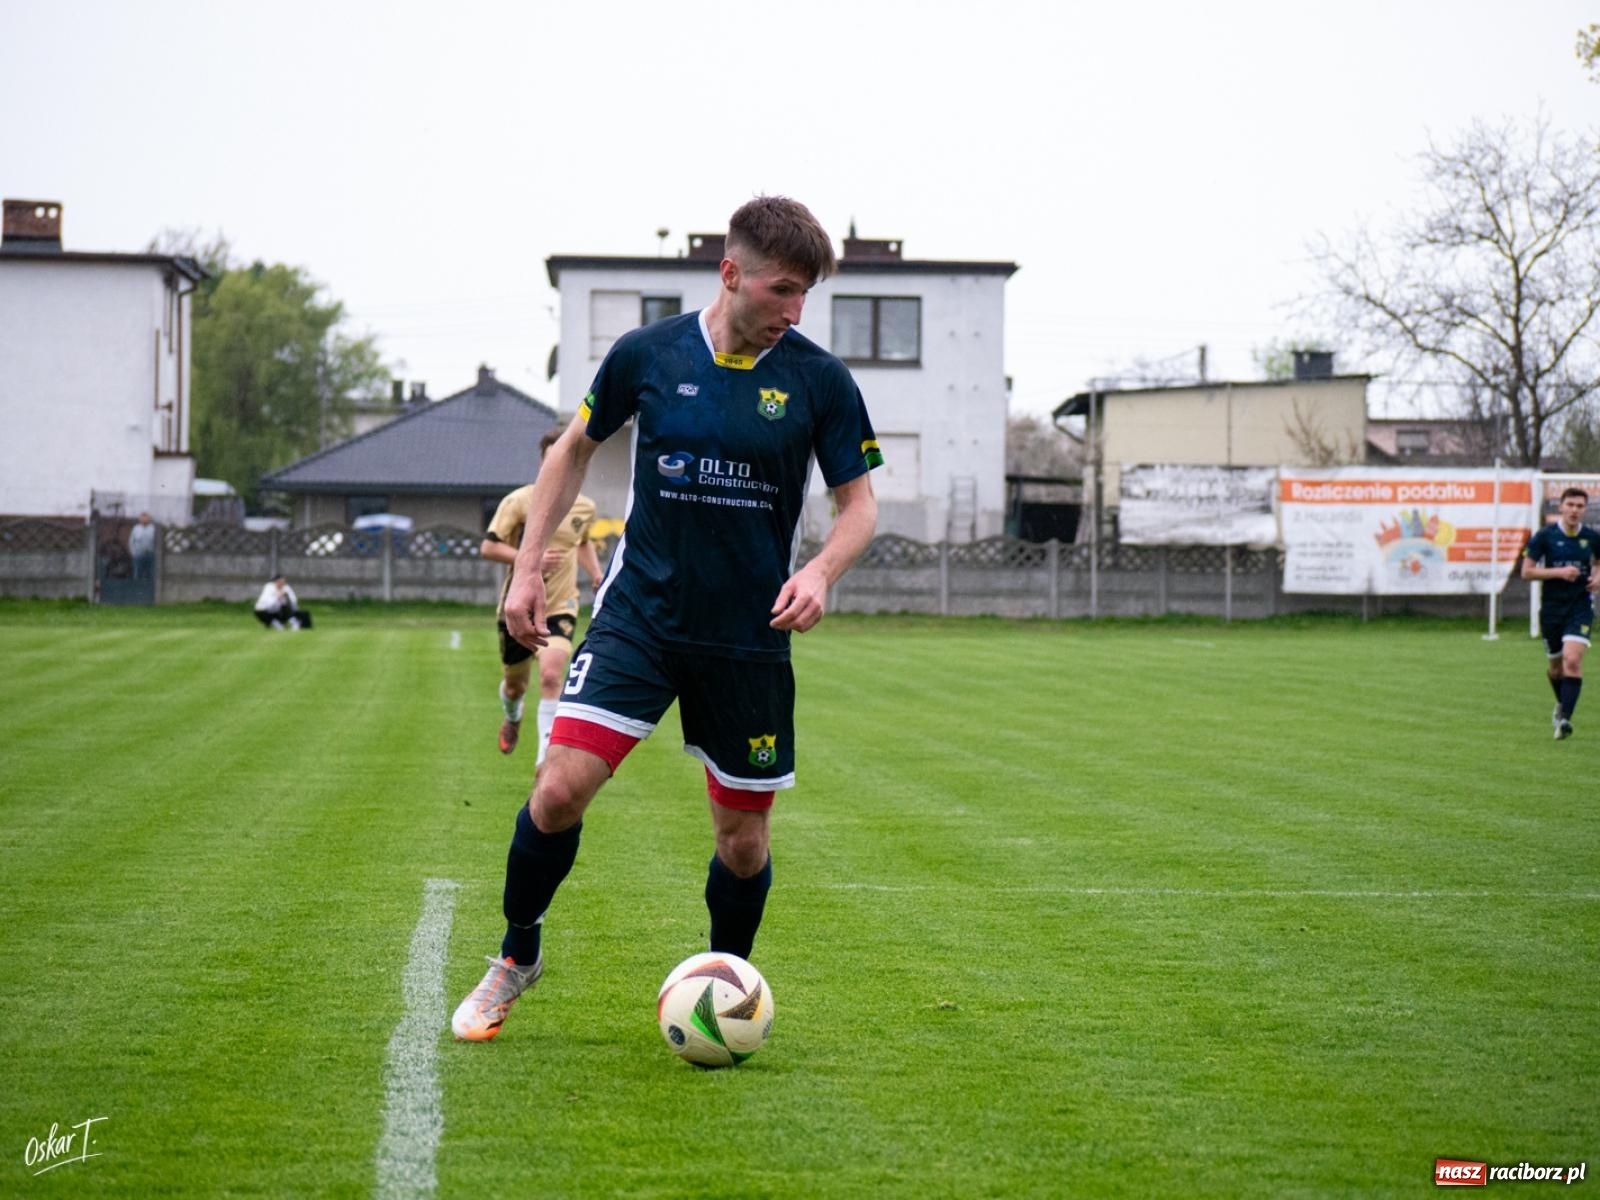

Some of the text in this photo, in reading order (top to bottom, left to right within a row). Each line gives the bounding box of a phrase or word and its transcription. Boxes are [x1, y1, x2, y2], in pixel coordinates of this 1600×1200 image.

[700, 458, 750, 478] OLTO
[698, 474, 779, 494] Construction
[1291, 483, 1392, 500] Rozliczenie
